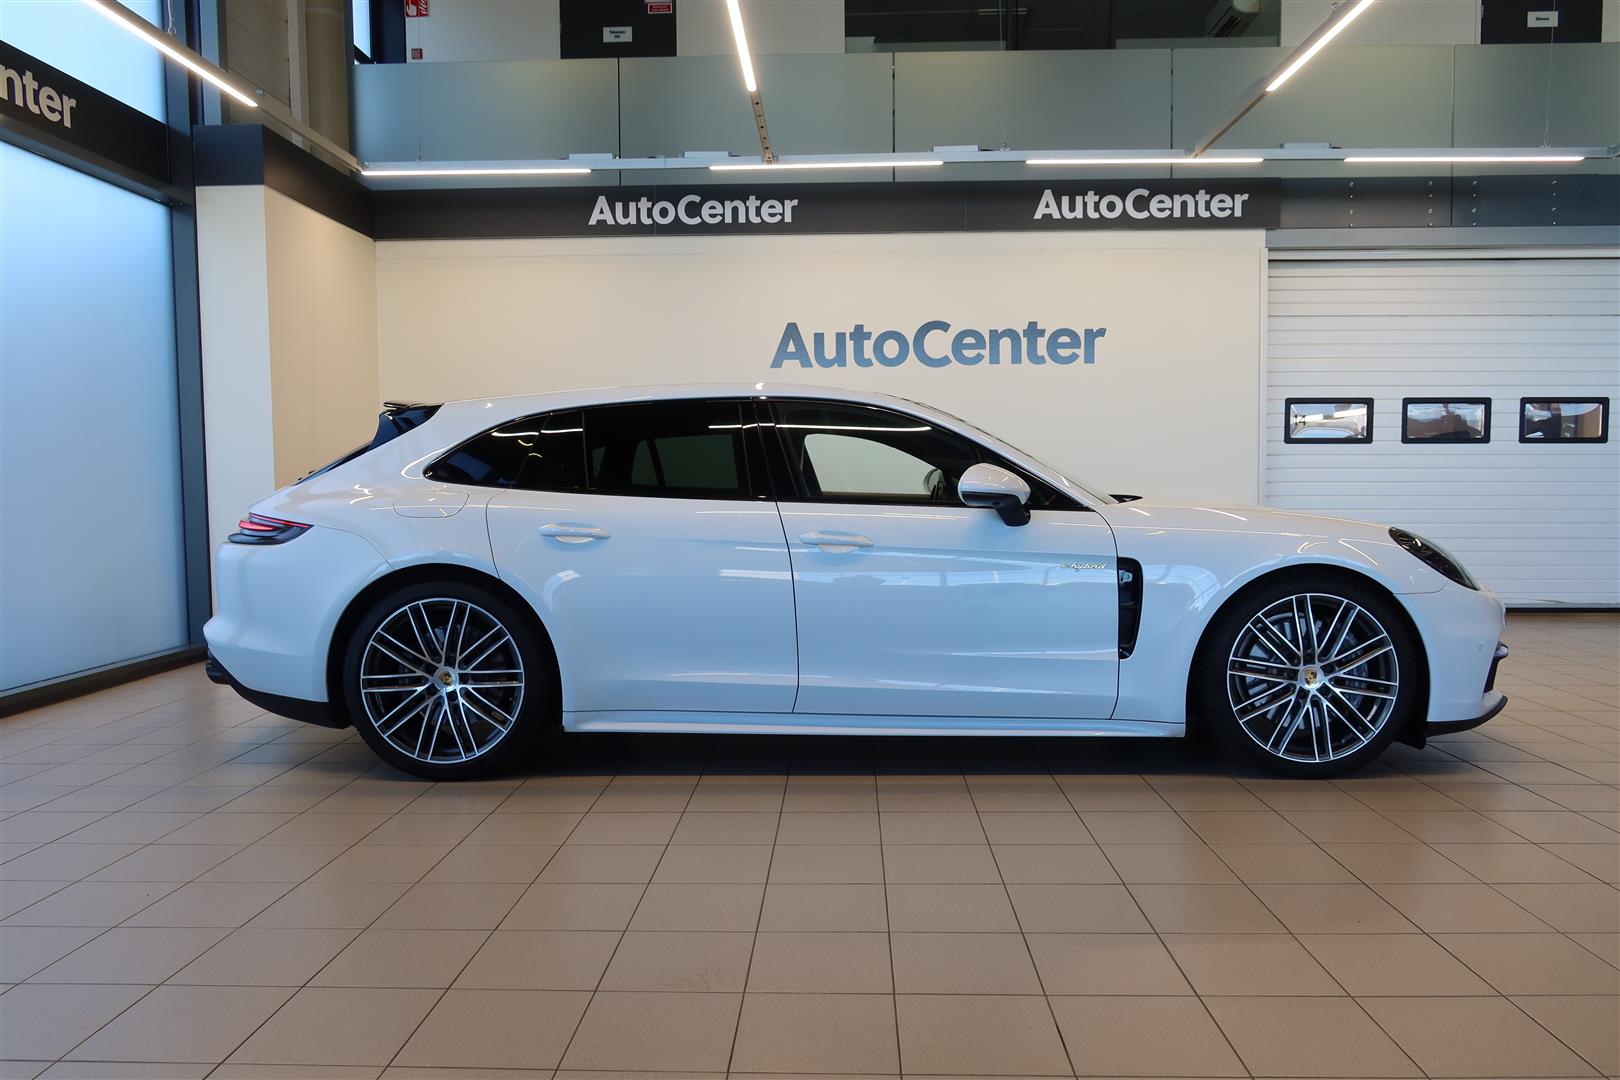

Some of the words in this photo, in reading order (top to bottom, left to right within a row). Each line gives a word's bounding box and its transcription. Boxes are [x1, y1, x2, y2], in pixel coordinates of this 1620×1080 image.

[588, 194, 799, 226] AutoCenter
[1033, 188, 1249, 220] AutoCenter
[770, 320, 1107, 369] AutoCenter
